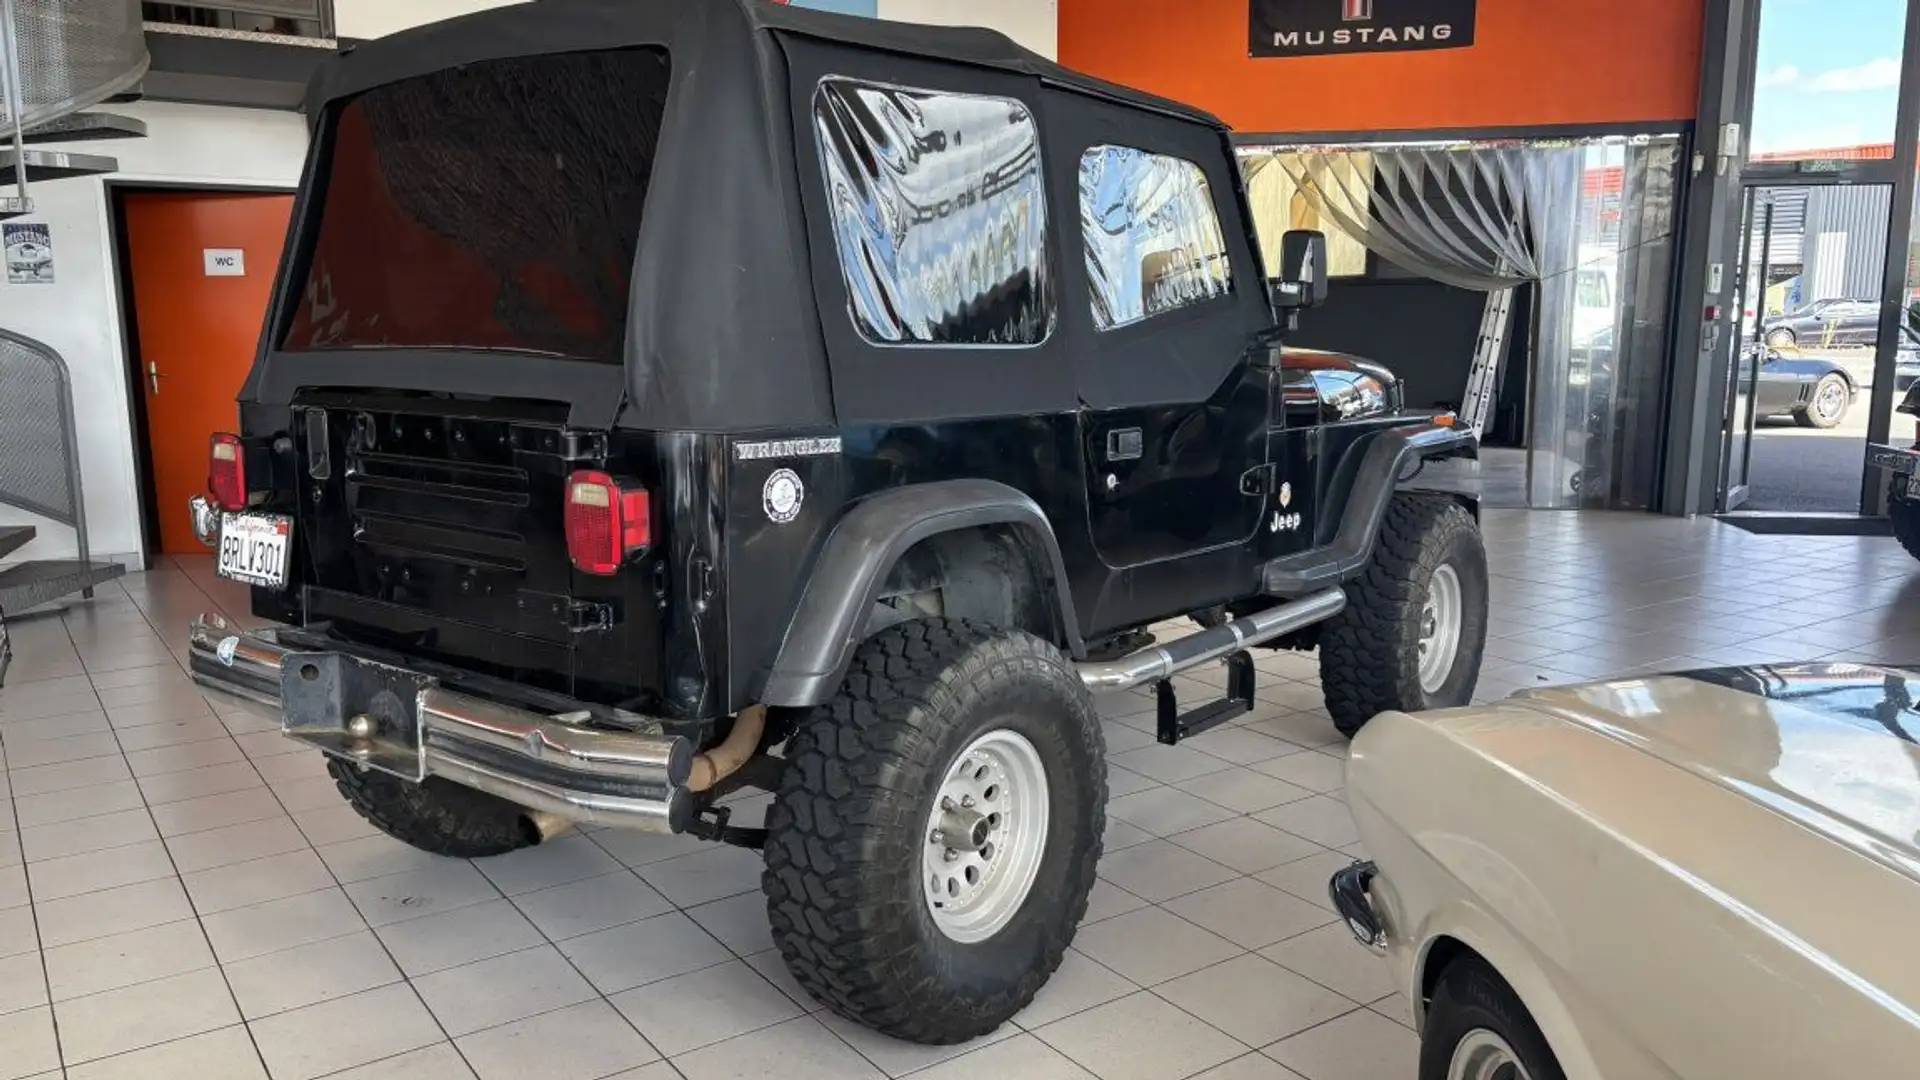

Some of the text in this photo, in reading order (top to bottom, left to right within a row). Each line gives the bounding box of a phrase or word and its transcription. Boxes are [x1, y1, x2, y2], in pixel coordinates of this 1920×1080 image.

[1273, 24, 1453, 47] MUSTANG
[215, 256, 234, 266] WC
[732, 436, 842, 460] WRANGLER
[1270, 510, 1301, 533] Jeep
[221, 535, 281, 578] 8RLV301
